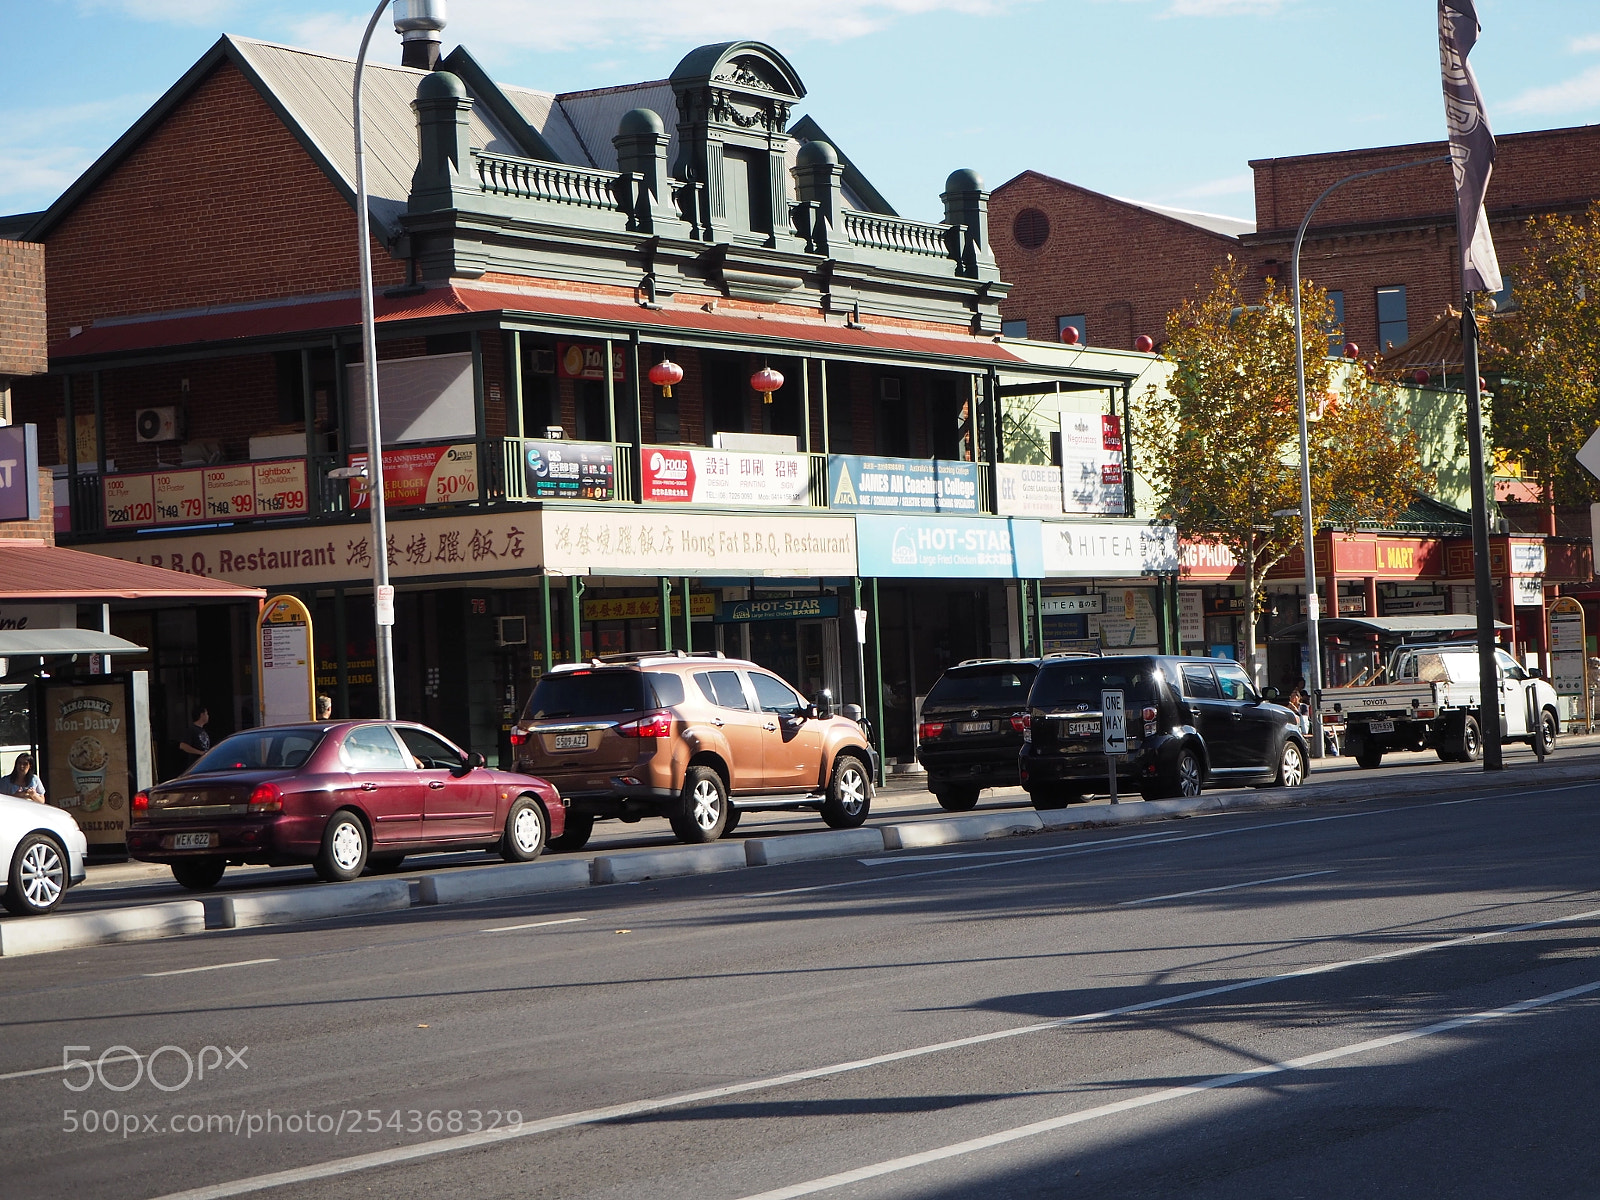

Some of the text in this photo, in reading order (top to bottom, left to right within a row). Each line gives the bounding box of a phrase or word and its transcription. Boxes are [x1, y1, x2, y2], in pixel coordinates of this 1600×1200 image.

[393, 453, 436, 464] ANNIVERSARY
[666, 459, 688, 470] FOCUS
[409, 462, 423, 471] great
[424, 460, 436, 468] offer
[706, 457, 798, 478] 設計 印刷 招牌
[0, 459, 17, 488] T
[207, 473, 225, 481] 1000
[257, 468, 291, 478] Lightbox
[1021, 469, 1061, 483] GLOBE ED
[107, 480, 124, 489] 1000
[157, 477, 171, 485] 100
[207, 479, 251, 489] Business Cards
[392, 479, 426, 489] BUDGET,
[437, 474, 474, 495] 50%
[859, 473, 889, 492] JAMES
[904, 475, 944, 497] Coaching
[944, 477, 975, 498] College
[117, 489, 129, 497] Flyer
[157, 484, 185, 493] A3 Poster
[398, 488, 419, 498] Now!
[231, 494, 252, 513] $99
[274, 490, 304, 510] $799
[840, 493, 852, 504] JAC
[124, 502, 153, 521] $120
[181, 498, 201, 517] $79
[681, 530, 850, 557] Hong Fat B.B.Q. Restaurant
[918, 527, 1011, 551] HOT-STAR
[219, 541, 336, 573] Restaurant
[919, 554, 977, 566] Large Fried Chicken
[1198, 543, 1245, 567] PHUON
[1387, 547, 1414, 569] MART
[471, 599, 486, 614] 75
[694, 596, 713, 605] B.B.Q.
[751, 599, 820, 612] HOT-STAR
[290, 613, 300, 621] W1
[83, 700, 111, 713] JERRY'S
[1105, 695, 1122, 710] ONE
[55, 717, 121, 734] Non-Dairy
[1105, 715, 1123, 730] WAY
[58, 795, 81, 808] NEW!
[103, 821, 124, 831] NOW
[176, 834, 209, 846] WEK 822
